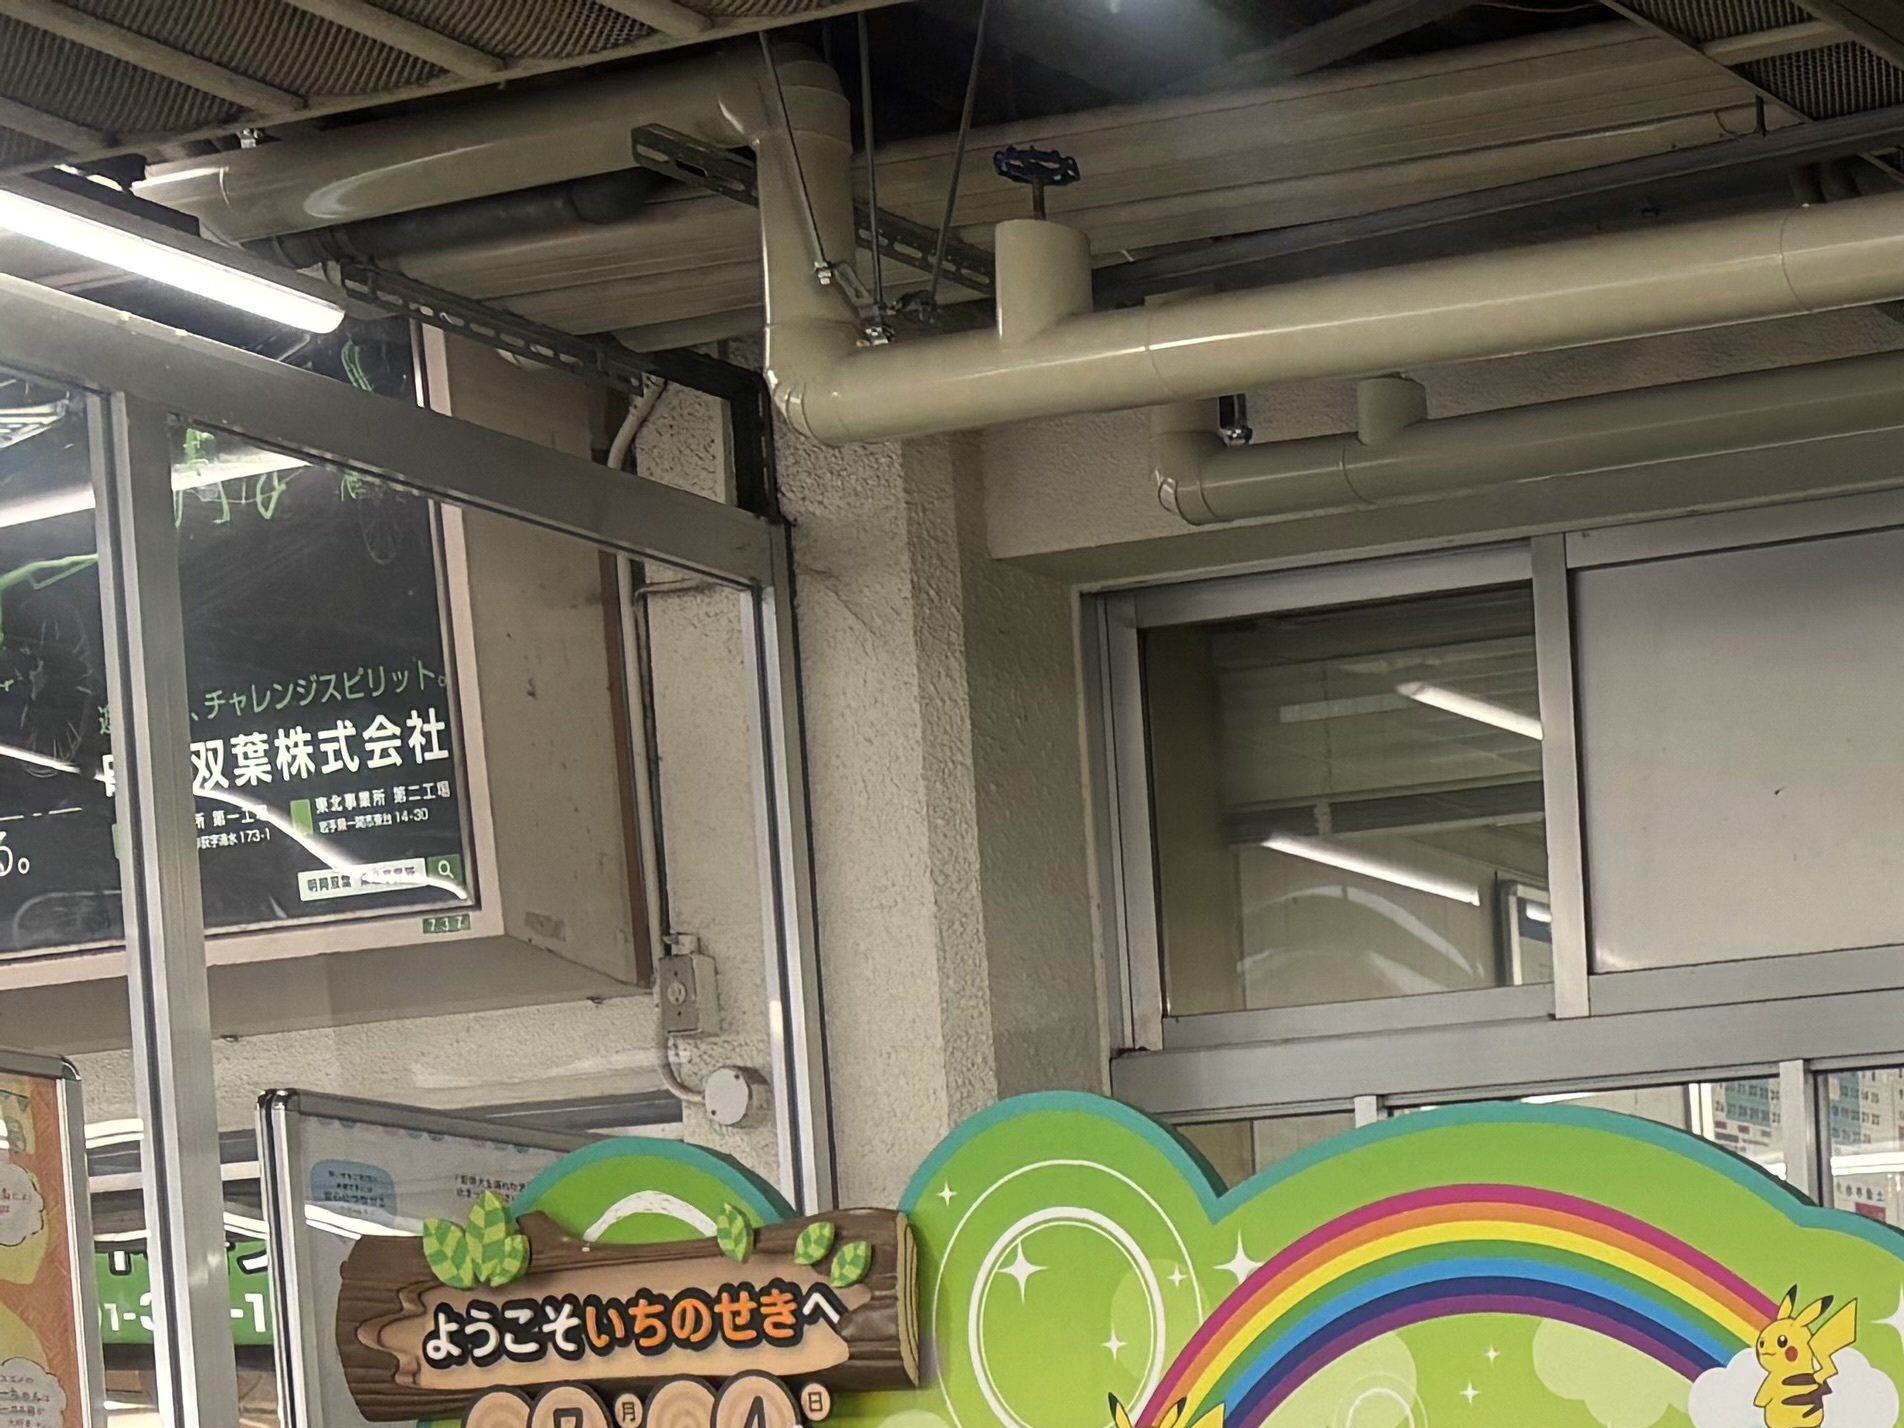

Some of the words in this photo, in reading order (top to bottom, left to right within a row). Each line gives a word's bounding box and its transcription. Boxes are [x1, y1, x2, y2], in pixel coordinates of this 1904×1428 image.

[424, 1287, 842, 1363] ようこそいちのせきへ
